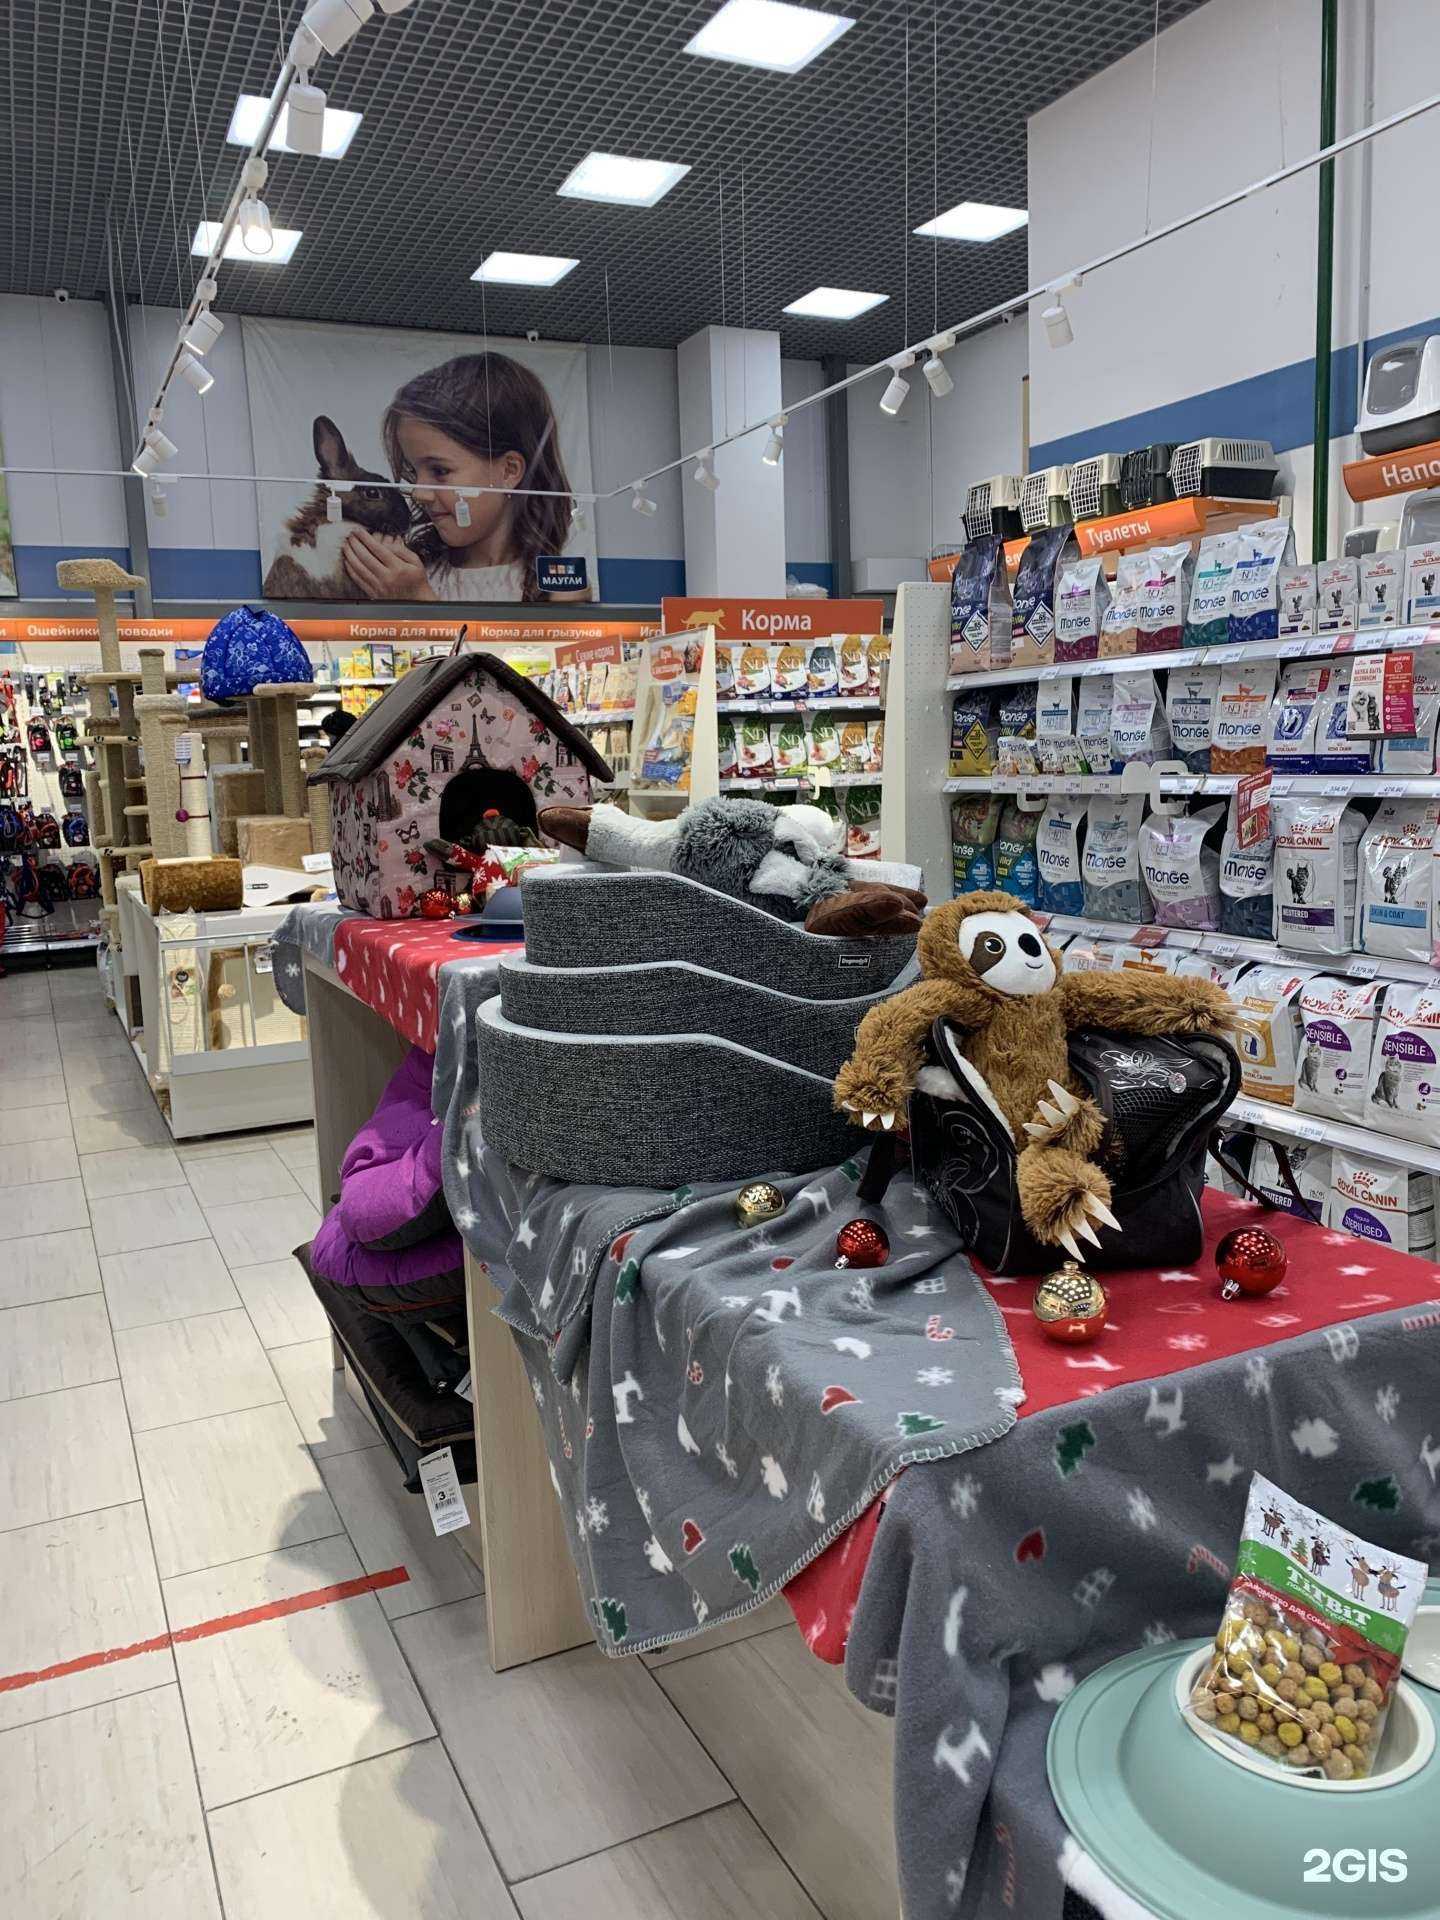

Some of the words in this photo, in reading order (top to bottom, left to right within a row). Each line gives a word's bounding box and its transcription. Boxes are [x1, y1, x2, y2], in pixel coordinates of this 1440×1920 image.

[1086, 520, 1152, 547] Туалеты
[542, 576, 583, 585] МАУГЛИ
[350, 624, 397, 637] Корма
[400, 626, 426, 637] для
[741, 608, 812, 636] Корма
[481, 626, 520, 638] Корма
[521, 627, 544, 638] для
[546, 628, 602, 638] грызунов
[1296, 836, 1322, 846] CANIN
[1389, 911, 1404, 920] COAT
[1306, 1026, 1342, 1045] SENSIBLE
[1384, 1038, 1426, 1057] SENSIBLE
[1337, 1177, 1359, 1198] ROYAL
[1361, 1189, 1398, 1207] CANIN
[1344, 1216, 1383, 1239] STERILISED
